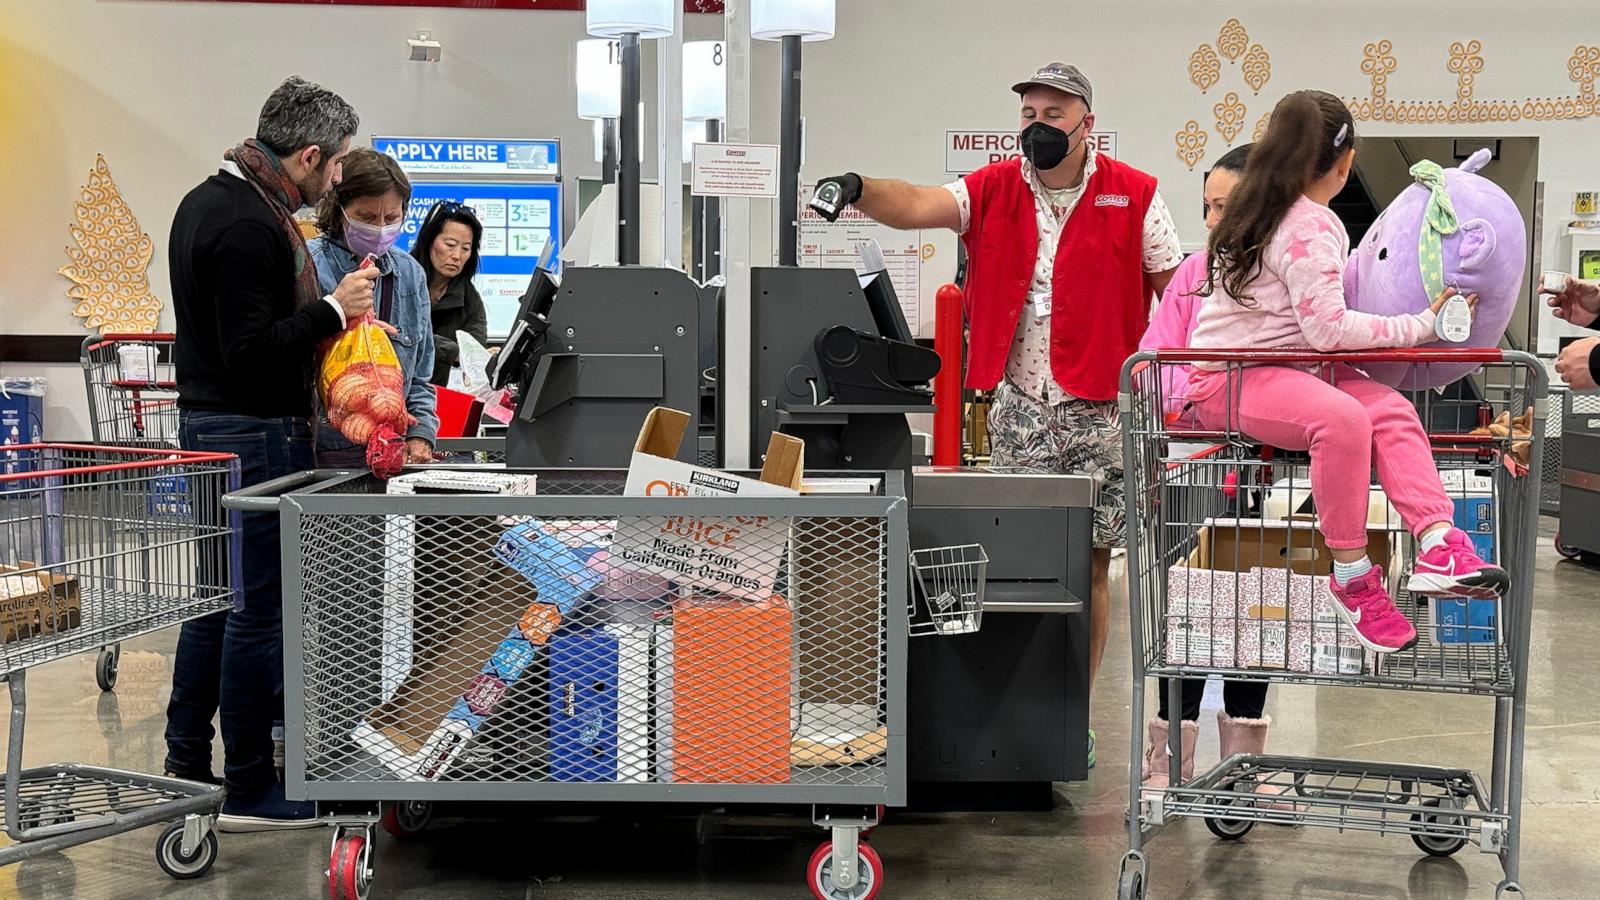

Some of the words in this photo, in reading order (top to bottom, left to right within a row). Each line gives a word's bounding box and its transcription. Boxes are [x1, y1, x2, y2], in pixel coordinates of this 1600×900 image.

[713, 43, 723, 66] 8
[953, 135, 1110, 151] MERCSE
[385, 143, 443, 161] APPLY
[448, 144, 498, 161] HERE
[413, 198, 433, 206] CASH
[1096, 195, 1128, 203] COSTCO
[670, 480, 691, 493] BEST
[693, 472, 738, 489] KIRKLAND
[660, 516, 740, 549] JUICE
[653, 538, 695, 558] Made
[699, 549, 738, 569] From
[622, 547, 693, 575] California
[698, 565, 761, 590] Oranges
